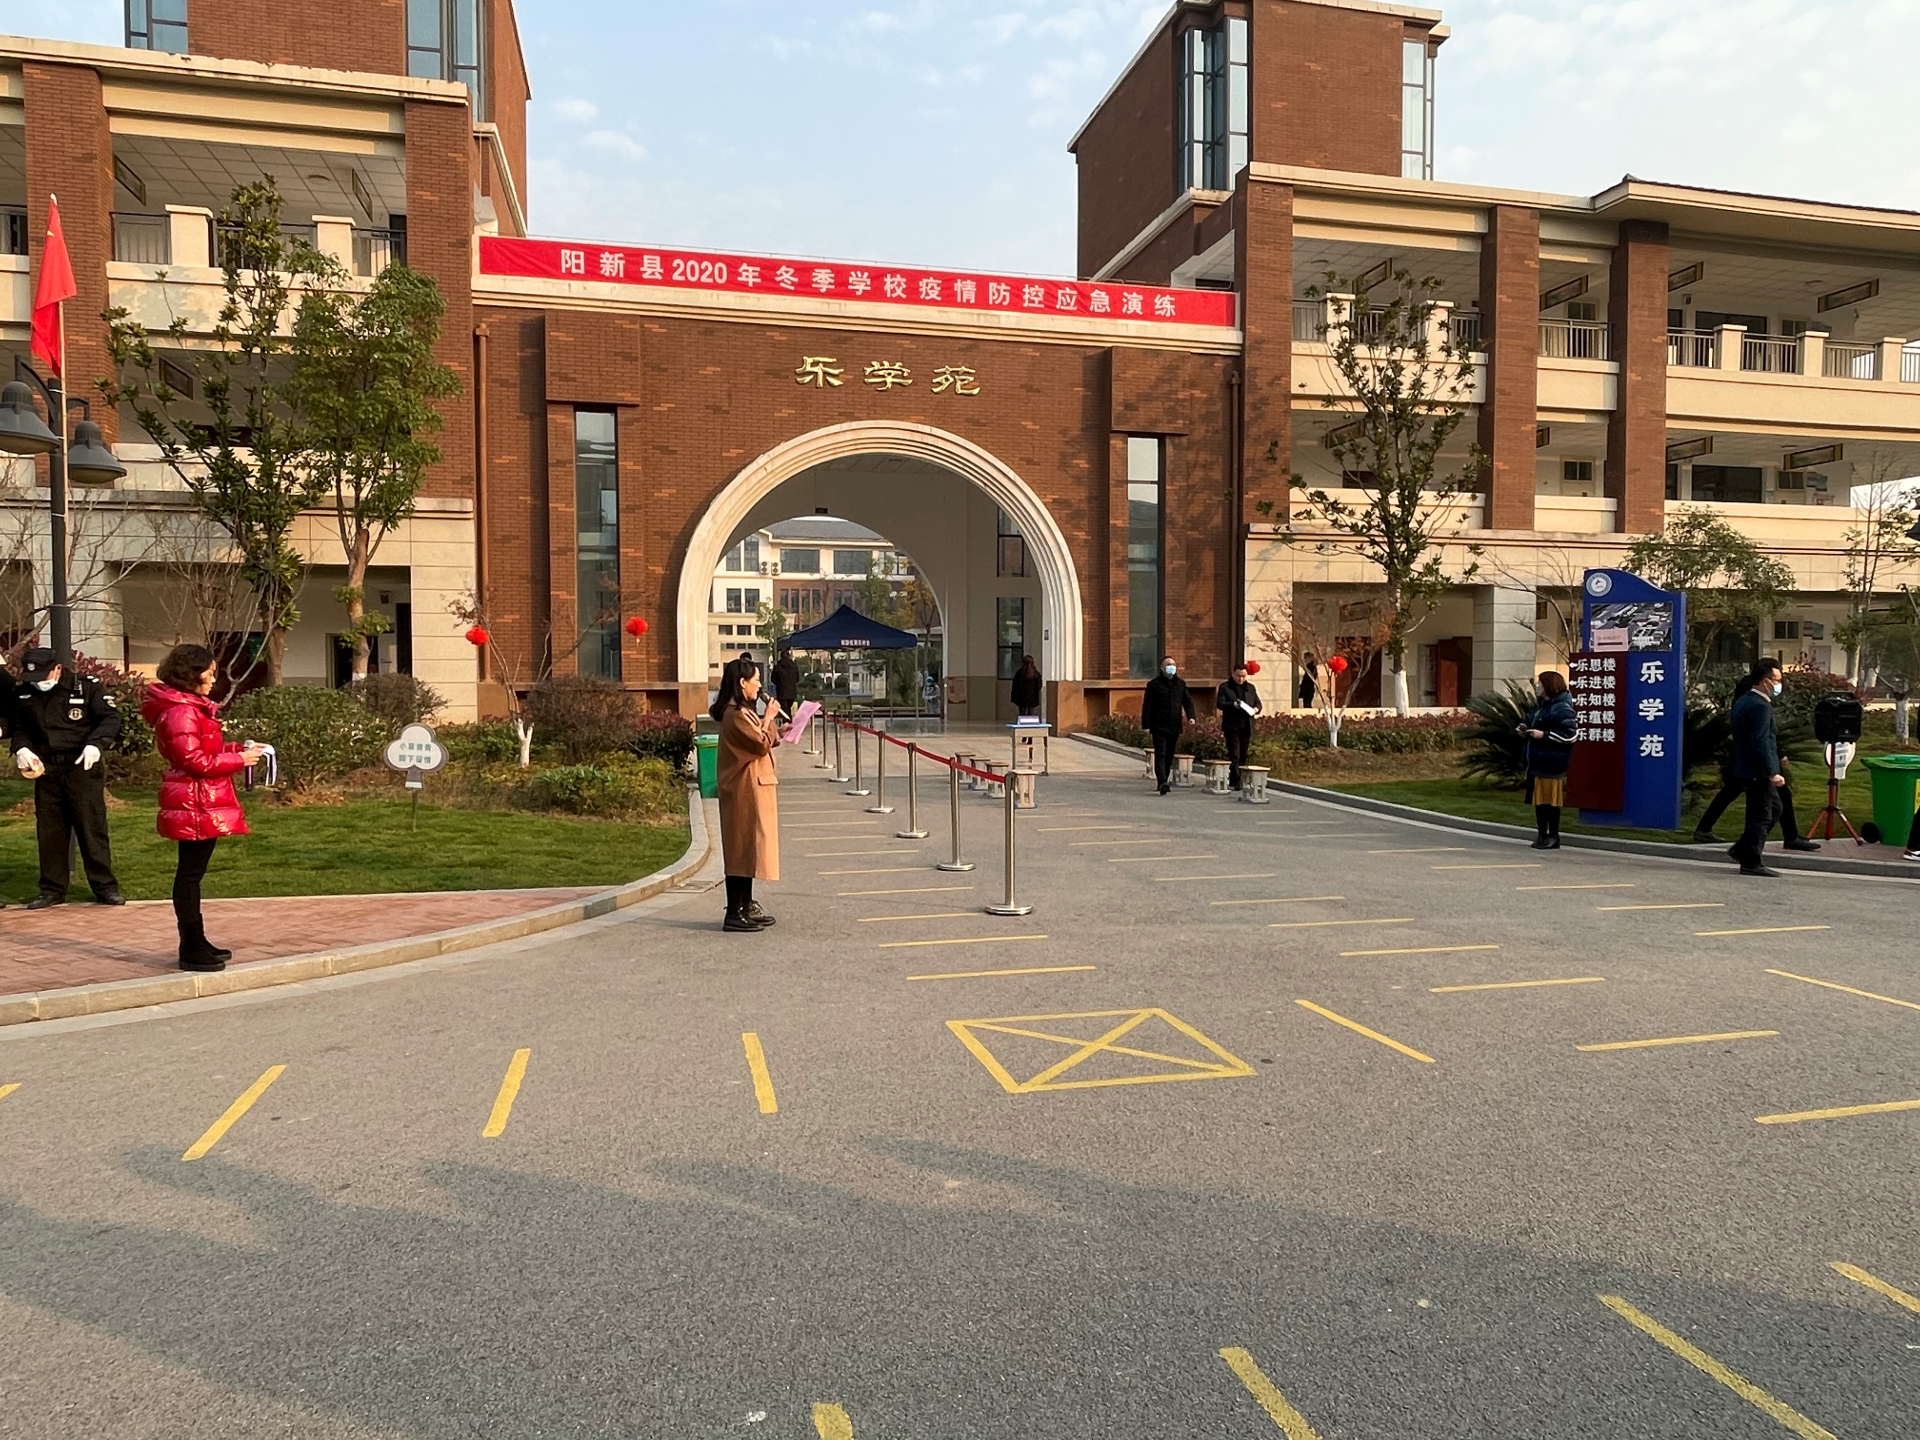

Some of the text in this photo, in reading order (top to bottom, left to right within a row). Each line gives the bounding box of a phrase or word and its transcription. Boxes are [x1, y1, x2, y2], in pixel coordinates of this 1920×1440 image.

[560, 248, 1177, 319] 阳新县2020年冬季学校疫情防控应急演练
[795, 355, 981, 396] 乐学苑
[1575, 658, 1616, 672] 乐思楼
[1575, 675, 1616, 689] 乐进楼
[1575, 693, 1616, 707] 乐知楼
[1638, 660, 1665, 757] 乐学苑
[1577, 728, 1616, 742] 乐群楼
